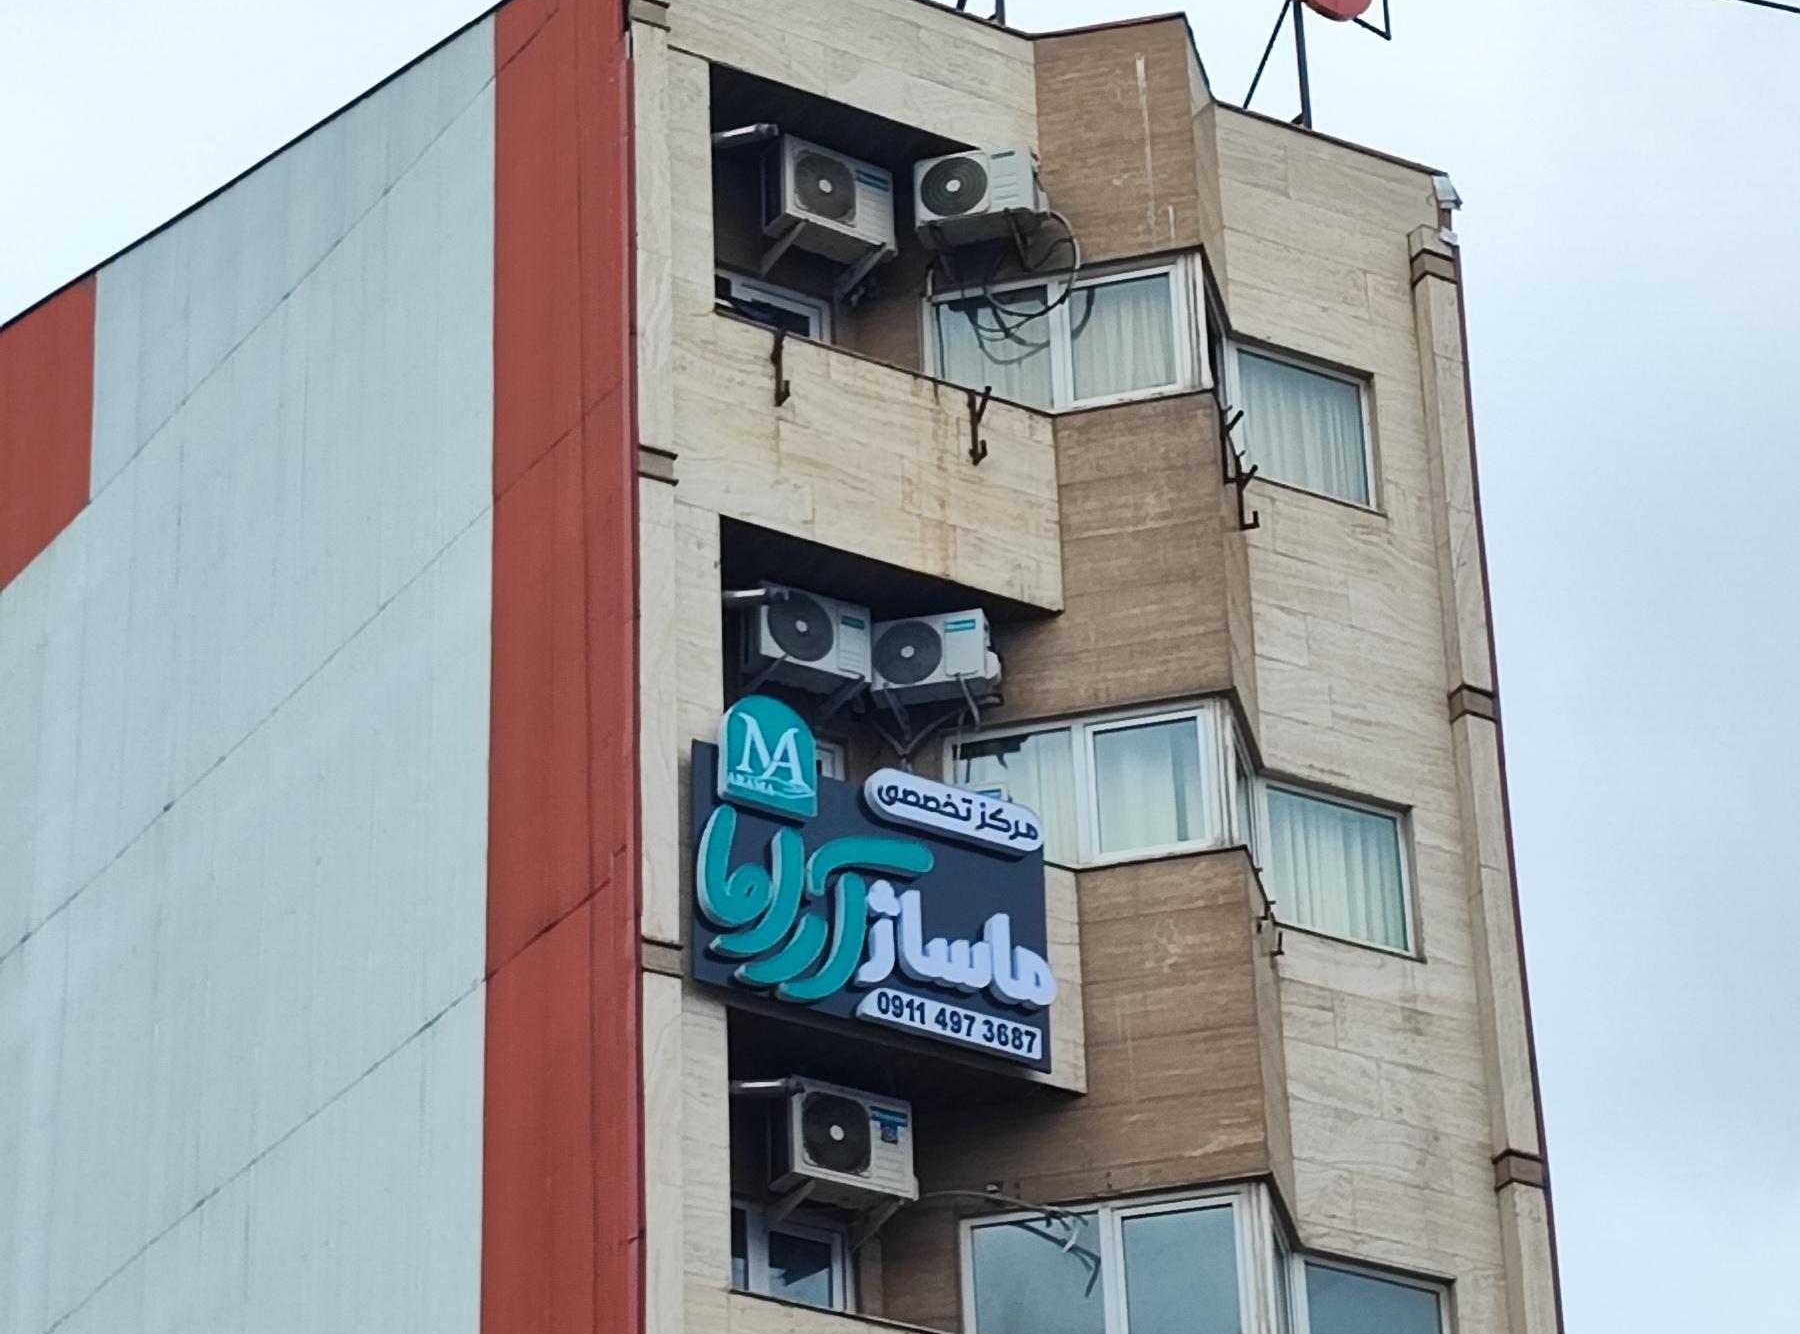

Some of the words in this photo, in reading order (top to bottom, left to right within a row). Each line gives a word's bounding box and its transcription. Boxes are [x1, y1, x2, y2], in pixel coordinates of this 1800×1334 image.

[877, 785, 973, 821] تخصصی
[975, 802, 1038, 840] مرکز
[855, 880, 1057, 1007] ماساژ
[877, 991, 926, 1025] 0911
[934, 1007, 976, 1037] 497
[982, 1019, 1037, 1053] 3687
